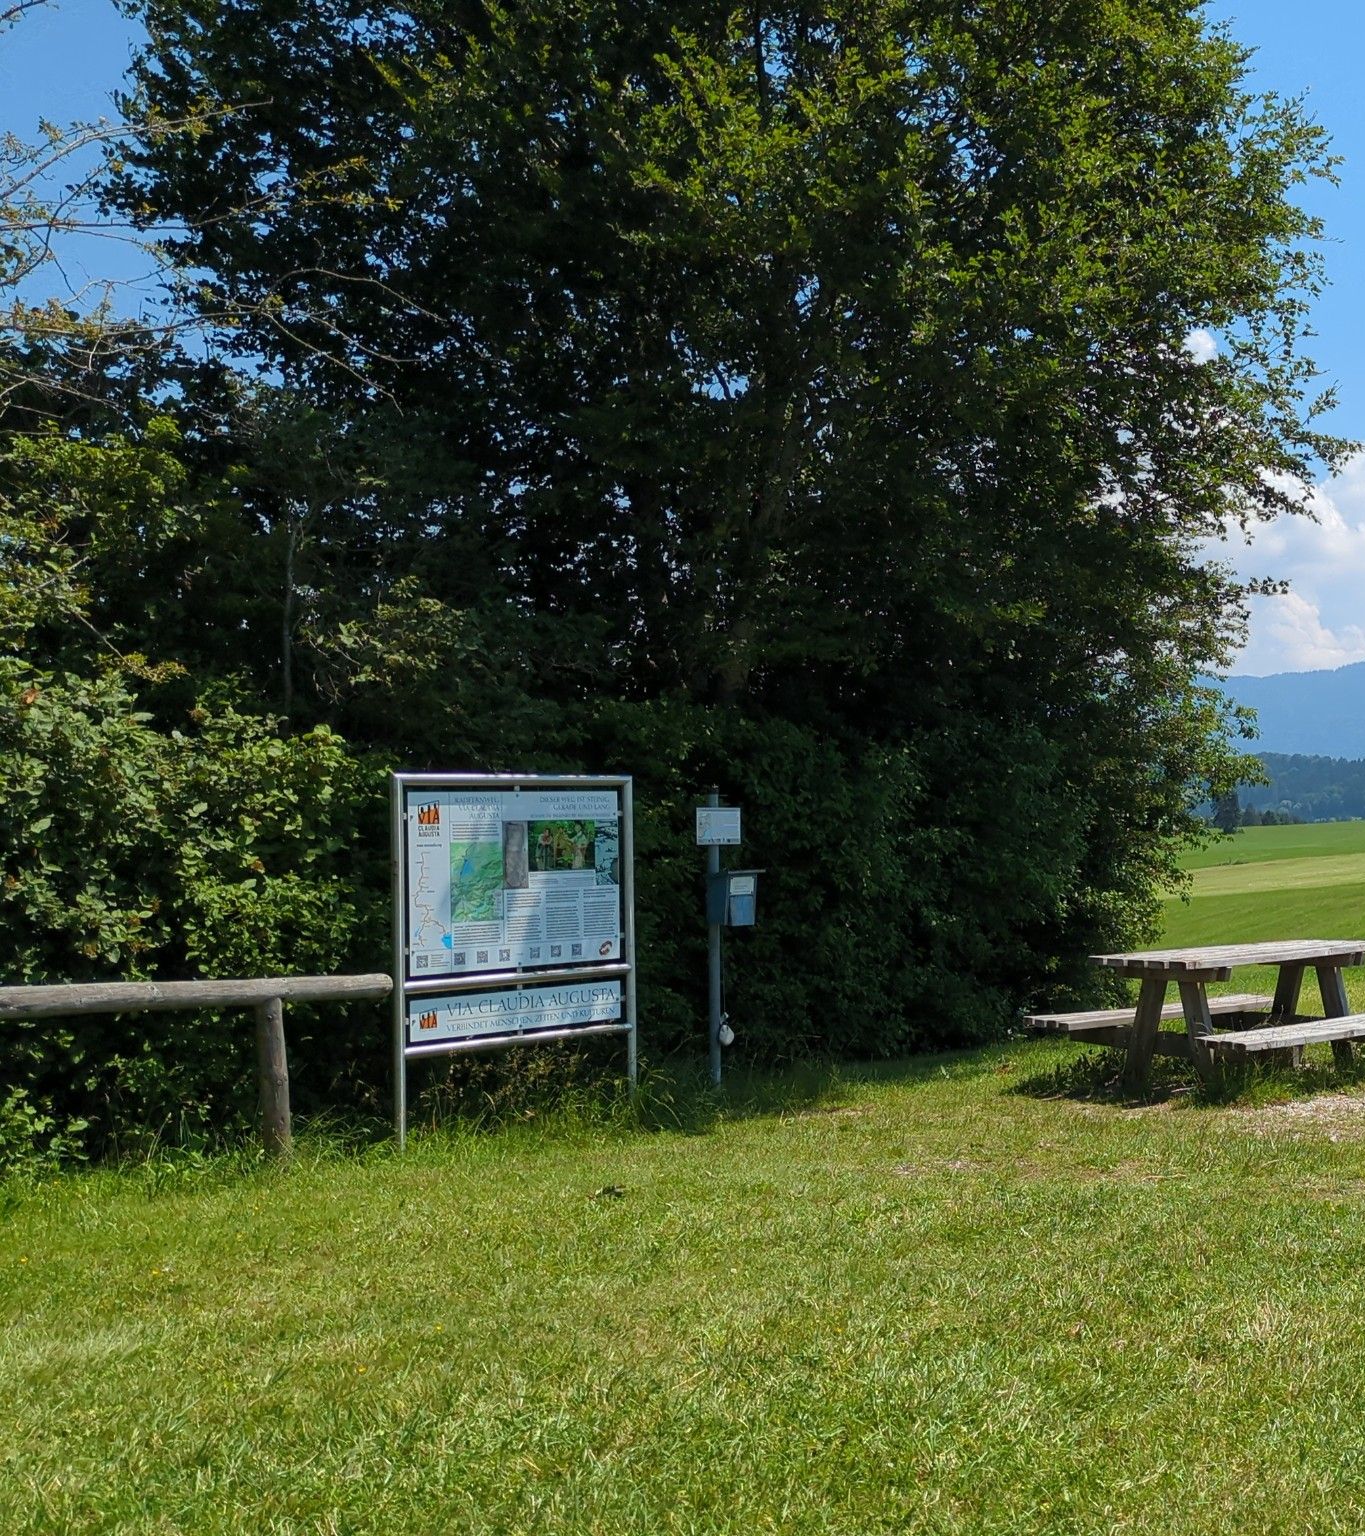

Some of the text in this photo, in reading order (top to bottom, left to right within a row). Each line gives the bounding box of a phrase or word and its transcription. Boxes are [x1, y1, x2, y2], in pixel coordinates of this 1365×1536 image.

[418, 803, 440, 824] VIA
[447, 987, 615, 1017] VIA CLAUDIA AUGUSTA
[420, 1010, 438, 1029] VIA
[446, 1020, 489, 1032] VERBINDET
